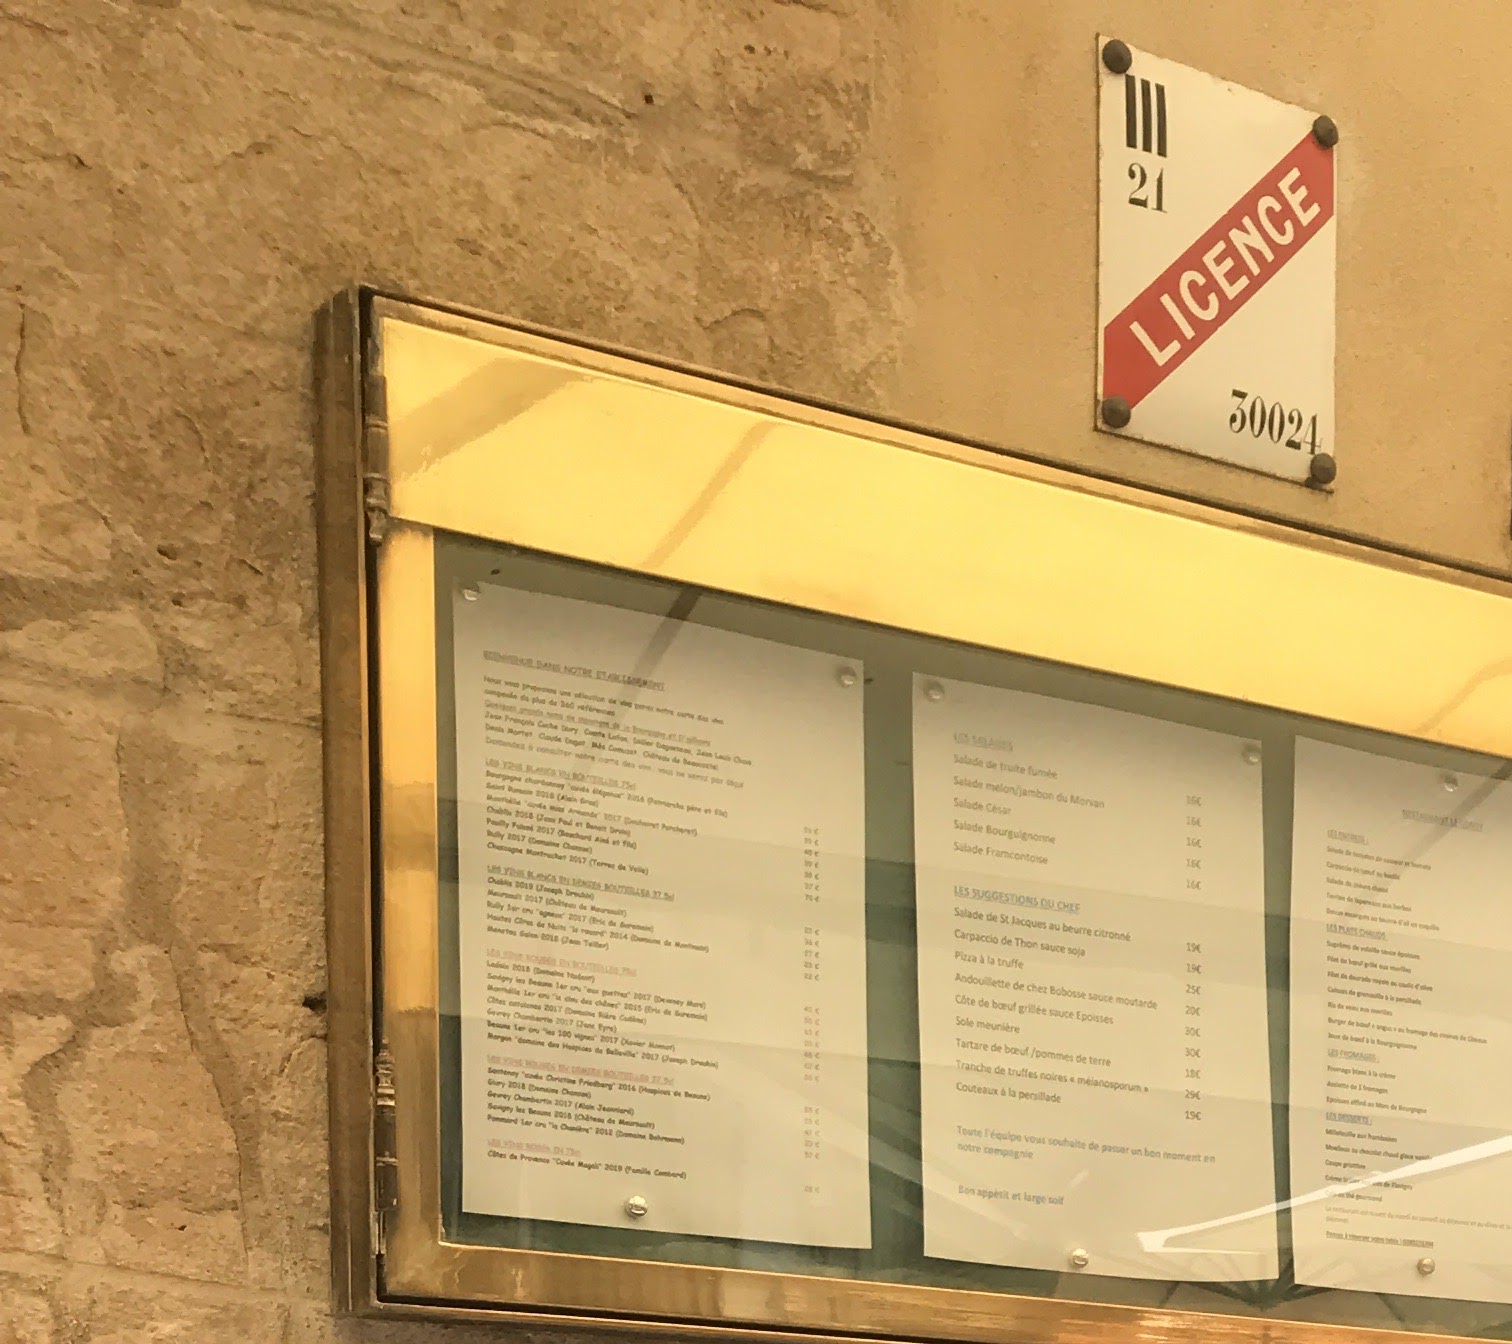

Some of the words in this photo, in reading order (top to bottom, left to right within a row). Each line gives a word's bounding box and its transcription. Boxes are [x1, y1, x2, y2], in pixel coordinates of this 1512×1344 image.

[1127, 162, 1168, 214] 21
[1129, 166, 1321, 367] LICENCE
[1229, 389, 1322, 455] 30024
[953, 753, 984, 767] Salade
[986, 758, 998, 769] de
[953, 775, 984, 789] Salade
[1056, 791, 1068, 802] du
[953, 797, 984, 811] Salade
[953, 819, 984, 833] Salade
[954, 886, 970, 898] LES
[1056, 900, 1080, 912] CHEF
[954, 906, 984, 920] Salade
[986, 911, 998, 922] de
[1000, 913, 1010, 924] St
[1011, 914, 1047, 930] Jacques
[1048, 923, 1060, 931] au
[1062, 922, 1092, 936] beurre
[954, 928, 998, 943] Carpaccio
[1000, 934, 1012, 945] de
[1014, 936, 1038, 948] Thon
[1040, 941, 1066, 951] sauce
[954, 950, 978, 962] Pizza
[987, 954, 996, 965] la
[997, 957, 1024, 969] truffe
[954, 971, 1010, 989] Andouillette
[1012, 980, 1024, 991] de
[1026, 982, 1048, 994] chez
[1088, 993, 1114, 1003] sauce
[956, 1016, 974, 1028] Sole
[956, 1038, 988, 1052] Tartare
[990, 1042, 1002, 1053] de
[1076, 1053, 1088, 1064] de
[1088, 1055, 1112, 1067] terre
[956, 1060, 992, 1074] Tranche
[956, 1081, 998, 1096] Couteaux
[1008, 1087, 1016, 1098] la
